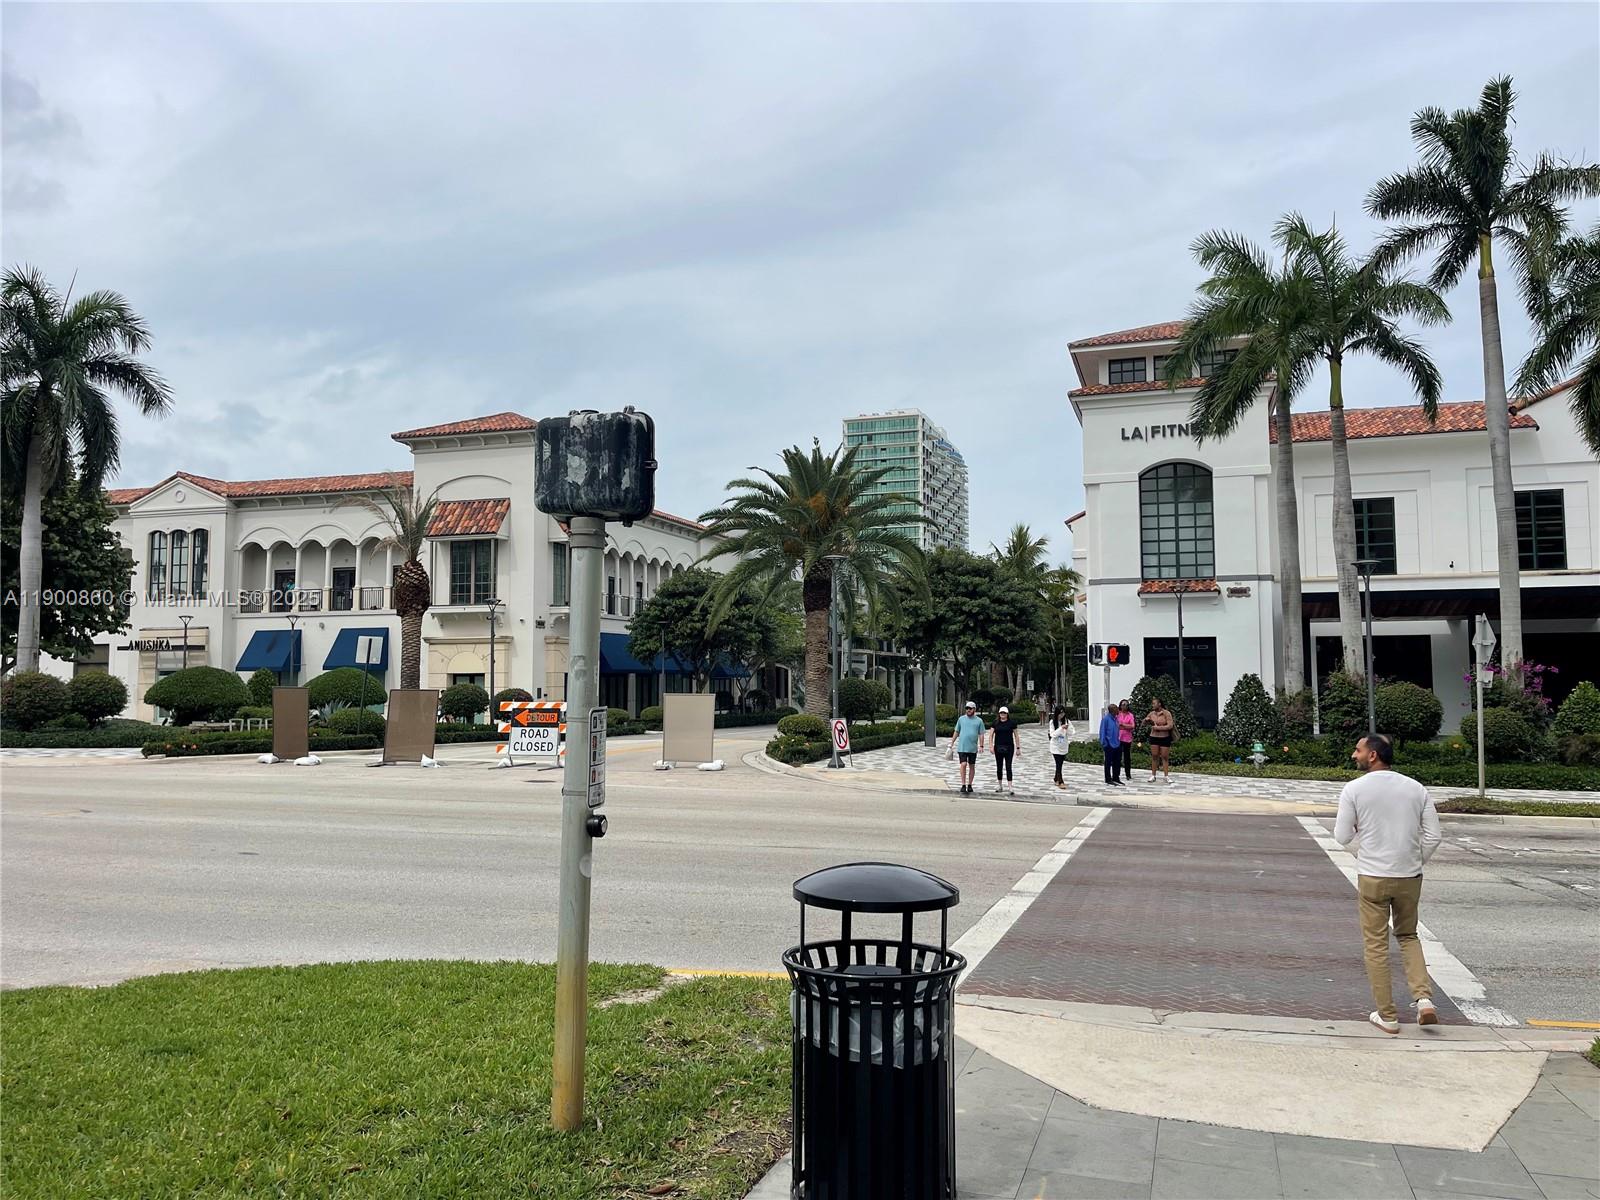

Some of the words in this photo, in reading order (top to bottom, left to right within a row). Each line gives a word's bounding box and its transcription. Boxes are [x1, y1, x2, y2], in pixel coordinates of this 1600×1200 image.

[1121, 426, 1143, 441] LA
[128, 639, 171, 651] ANUSHKA
[526, 712, 556, 722] DETOUR
[520, 728, 549, 739] ROAD
[513, 741, 554, 752] CLOSED
